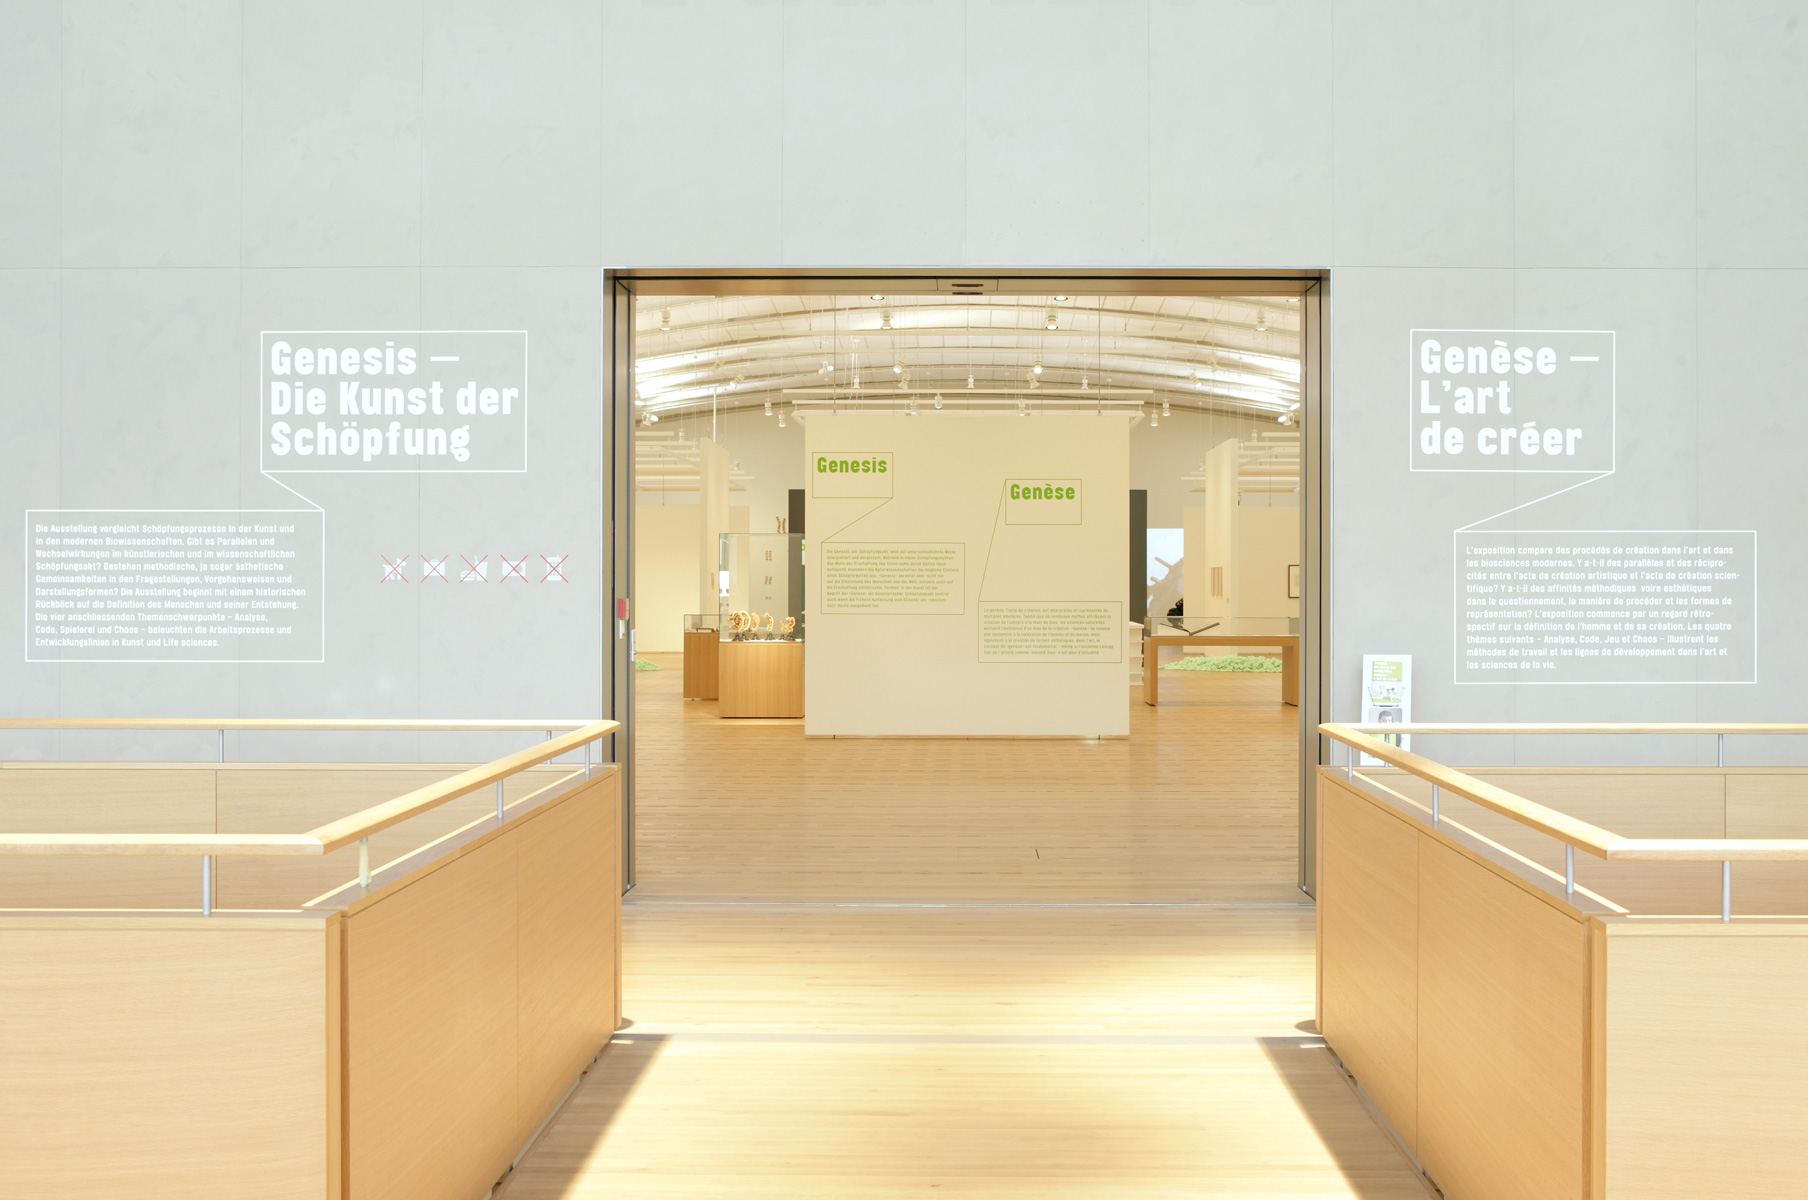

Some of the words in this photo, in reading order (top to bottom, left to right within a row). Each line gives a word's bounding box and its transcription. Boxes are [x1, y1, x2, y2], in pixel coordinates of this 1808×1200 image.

[271, 341, 416, 375] Genesis
[1421, 339, 1556, 374] Genèse
[271, 381, 326, 415] Die
[340, 381, 444, 415] Kunst
[457, 381, 518, 415] der
[1421, 380, 1511, 414] L'art
[271, 421, 470, 462] Schöpfung
[1421, 421, 1463, 454] de
[1478, 422, 1582, 455] créer
[817, 457, 887, 473] Genesis
[1011, 483, 1075, 500] Genèse
[36, 524, 48, 533] Die
[50, 524, 97, 534] Ausstellung
[99, 524, 140, 534] vergleicht
[142, 524, 226, 534] Schöpfungsprozesse
[228, 524, 236, 533] in
[238, 525, 252, 533] der
[254, 524, 277, 533] Kunst
[279, 524, 294, 533] und
[36, 537, 43, 545] in
[45, 537, 61, 545] den
[63, 537, 103, 545] modernen
[105, 537, 185, 546] Biowissenschaften.
[186, 537, 203, 546] Gibt
[217, 537, 258, 545] Parallelen
[259, 537, 275, 545] und
[35, 549, 110, 559] Wechselwirkungen
[112, 550, 122, 558] im
[124, 549, 185, 558] künstlerischen
[187, 550, 202, 558] und
[204, 550, 214, 558] im
[216, 549, 295, 558] wissenschaftlichen
[1466, 546, 1515, 556] L'exposition
[1517, 547, 1553, 556] compare
[1555, 546, 1570, 554] des
[1572, 546, 1611, 556] procédés
[1613, 546, 1623, 554] de
[1625, 546, 1660, 554] création
[1661, 546, 1682, 554] dans
[1683, 546, 1701, 554] l'art
[1703, 546, 1711, 554] et
[1713, 546, 1733, 554] dans
[35, 562, 101, 572] Schöpfungsakt?
[103, 562, 141, 571] Bestehen
[143, 562, 198, 571] methodische,
[199, 562, 208, 572] ja
[210, 563, 233, 572] sogar
[235, 562, 283, 571] ästhetische
[1466, 559, 1479, 567] les
[1481, 559, 1530, 567] biosciences
[1532, 559, 1575, 567] modernes.
[1577, 559, 1582, 567] Y
[1584, 559, 1605, 567] a-t-il
[1606, 558, 1622, 567] des
[1624, 559, 1664, 568] parallèles
[1666, 559, 1675, 567] et
[1677, 559, 1692, 567] des
[1694, 559, 1727, 568] récipro-
[35, 574, 107, 583] Gemeinsamkeiten
[109, 575, 116, 583] in
[118, 575, 134, 583] den
[135, 575, 202, 585] Fragestellungen,
[204, 575, 275, 585] Vorgehensweisen
[276, 575, 292, 583] und
[35, 587, 119, 597] Darstellungsformen?
[120, 587, 133, 596] Die
[135, 587, 181, 597] Ausstellung
[183, 587, 212, 598] beginnt
[214, 588, 227, 596] mit
[229, 588, 254, 596] einem
[256, 588, 306, 596] historischen
[1466, 584, 1498, 594] tifique?
[1500, 584, 1506, 592] Y
[1507, 584, 1528, 593] a-t-il
[1530, 584, 1545, 593] des
[1547, 584, 1582, 593] affinités
[1584, 584, 1637, 594] méthodiques
[1641, 584, 1661, 592] voire
[1663, 584, 1712, 594] esthétiques
[35, 600, 75, 608] Rückblick
[77, 600, 90, 608] auf
[92, 600, 105, 608] die
[106, 600, 145, 608] Definition
[147, 600, 162, 609] des
[164, 600, 205, 609] Menschen
[206, 600, 221, 609] und
[223, 600, 249, 609] seiner
[251, 600, 299, 610] Entstehung.
[1466, 597, 1487, 606] dans
[1488, 597, 1496, 605] le
[1498, 597, 1566, 607] questionnement,
[1568, 597, 1576, 605] la
[1578, 597, 1611, 605] manière
[1613, 597, 1624, 605] de
[1626, 597, 1663, 606] procéder
[1665, 597, 1674, 605] et
[1676, 597, 1688, 605] les
[1691, 597, 1720, 605] formes
[1722, 597, 1732, 605] de
[35, 613, 48, 621] Die
[50, 613, 65, 621] vier
[68, 613, 135, 621] anschliessenden
[137, 612, 225, 623] Themenschwerpunkte
[234, 613, 268, 623] Analyse,
[1466, 609, 1533, 620] représentation?
[1535, 609, 1584, 619] L'exposition
[1632, 611, 1646, 619] par
[1661, 609, 1688, 619] regard
[1690, 609, 1714, 618] rétro-
[35, 625, 58, 634] Code,
[60, 625, 95, 635] Spielerei
[97, 625, 112, 634] und
[114, 625, 138, 634] Chaos
[148, 625, 193, 634] beleuchten
[194, 625, 207, 634] die
[209, 625, 275, 635] Arbeitsprozesse
[277, 626, 292, 634] und
[1466, 622, 1496, 632] spectif
[1514, 622, 1522, 631] la
[1524, 622, 1563, 631] définition
[1565, 622, 1575, 631] de
[1577, 622, 1611, 631] l'homme
[1613, 622, 1622, 631] et
[1624, 622, 1634, 631] de
[1637, 623, 1647, 631] sa
[1649, 622, 1685, 631] création.
[1687, 622, 1702, 630] Les
[1705, 622, 1731, 632] quatre
[35, 638, 110, 648] Entwicklungslinien
[112, 638, 119, 646] in
[121, 638, 144, 646] Kunst
[146, 638, 161, 646] und
[163, 638, 179, 647] Life
[181, 638, 220, 647] sciences.
[1467, 635, 1497, 644] thèmes
[1499, 635, 1534, 644] suivants
[1543, 635, 1578, 645] Analyse,
[1579, 635, 1602, 644] Code,
[1604, 635, 1620, 643] Jeu
[1622, 635, 1630, 643] et
[1632, 635, 1657, 643] Chaos
[1667, 635, 1704, 643] illustrent
[1706, 635, 1719, 643] les
